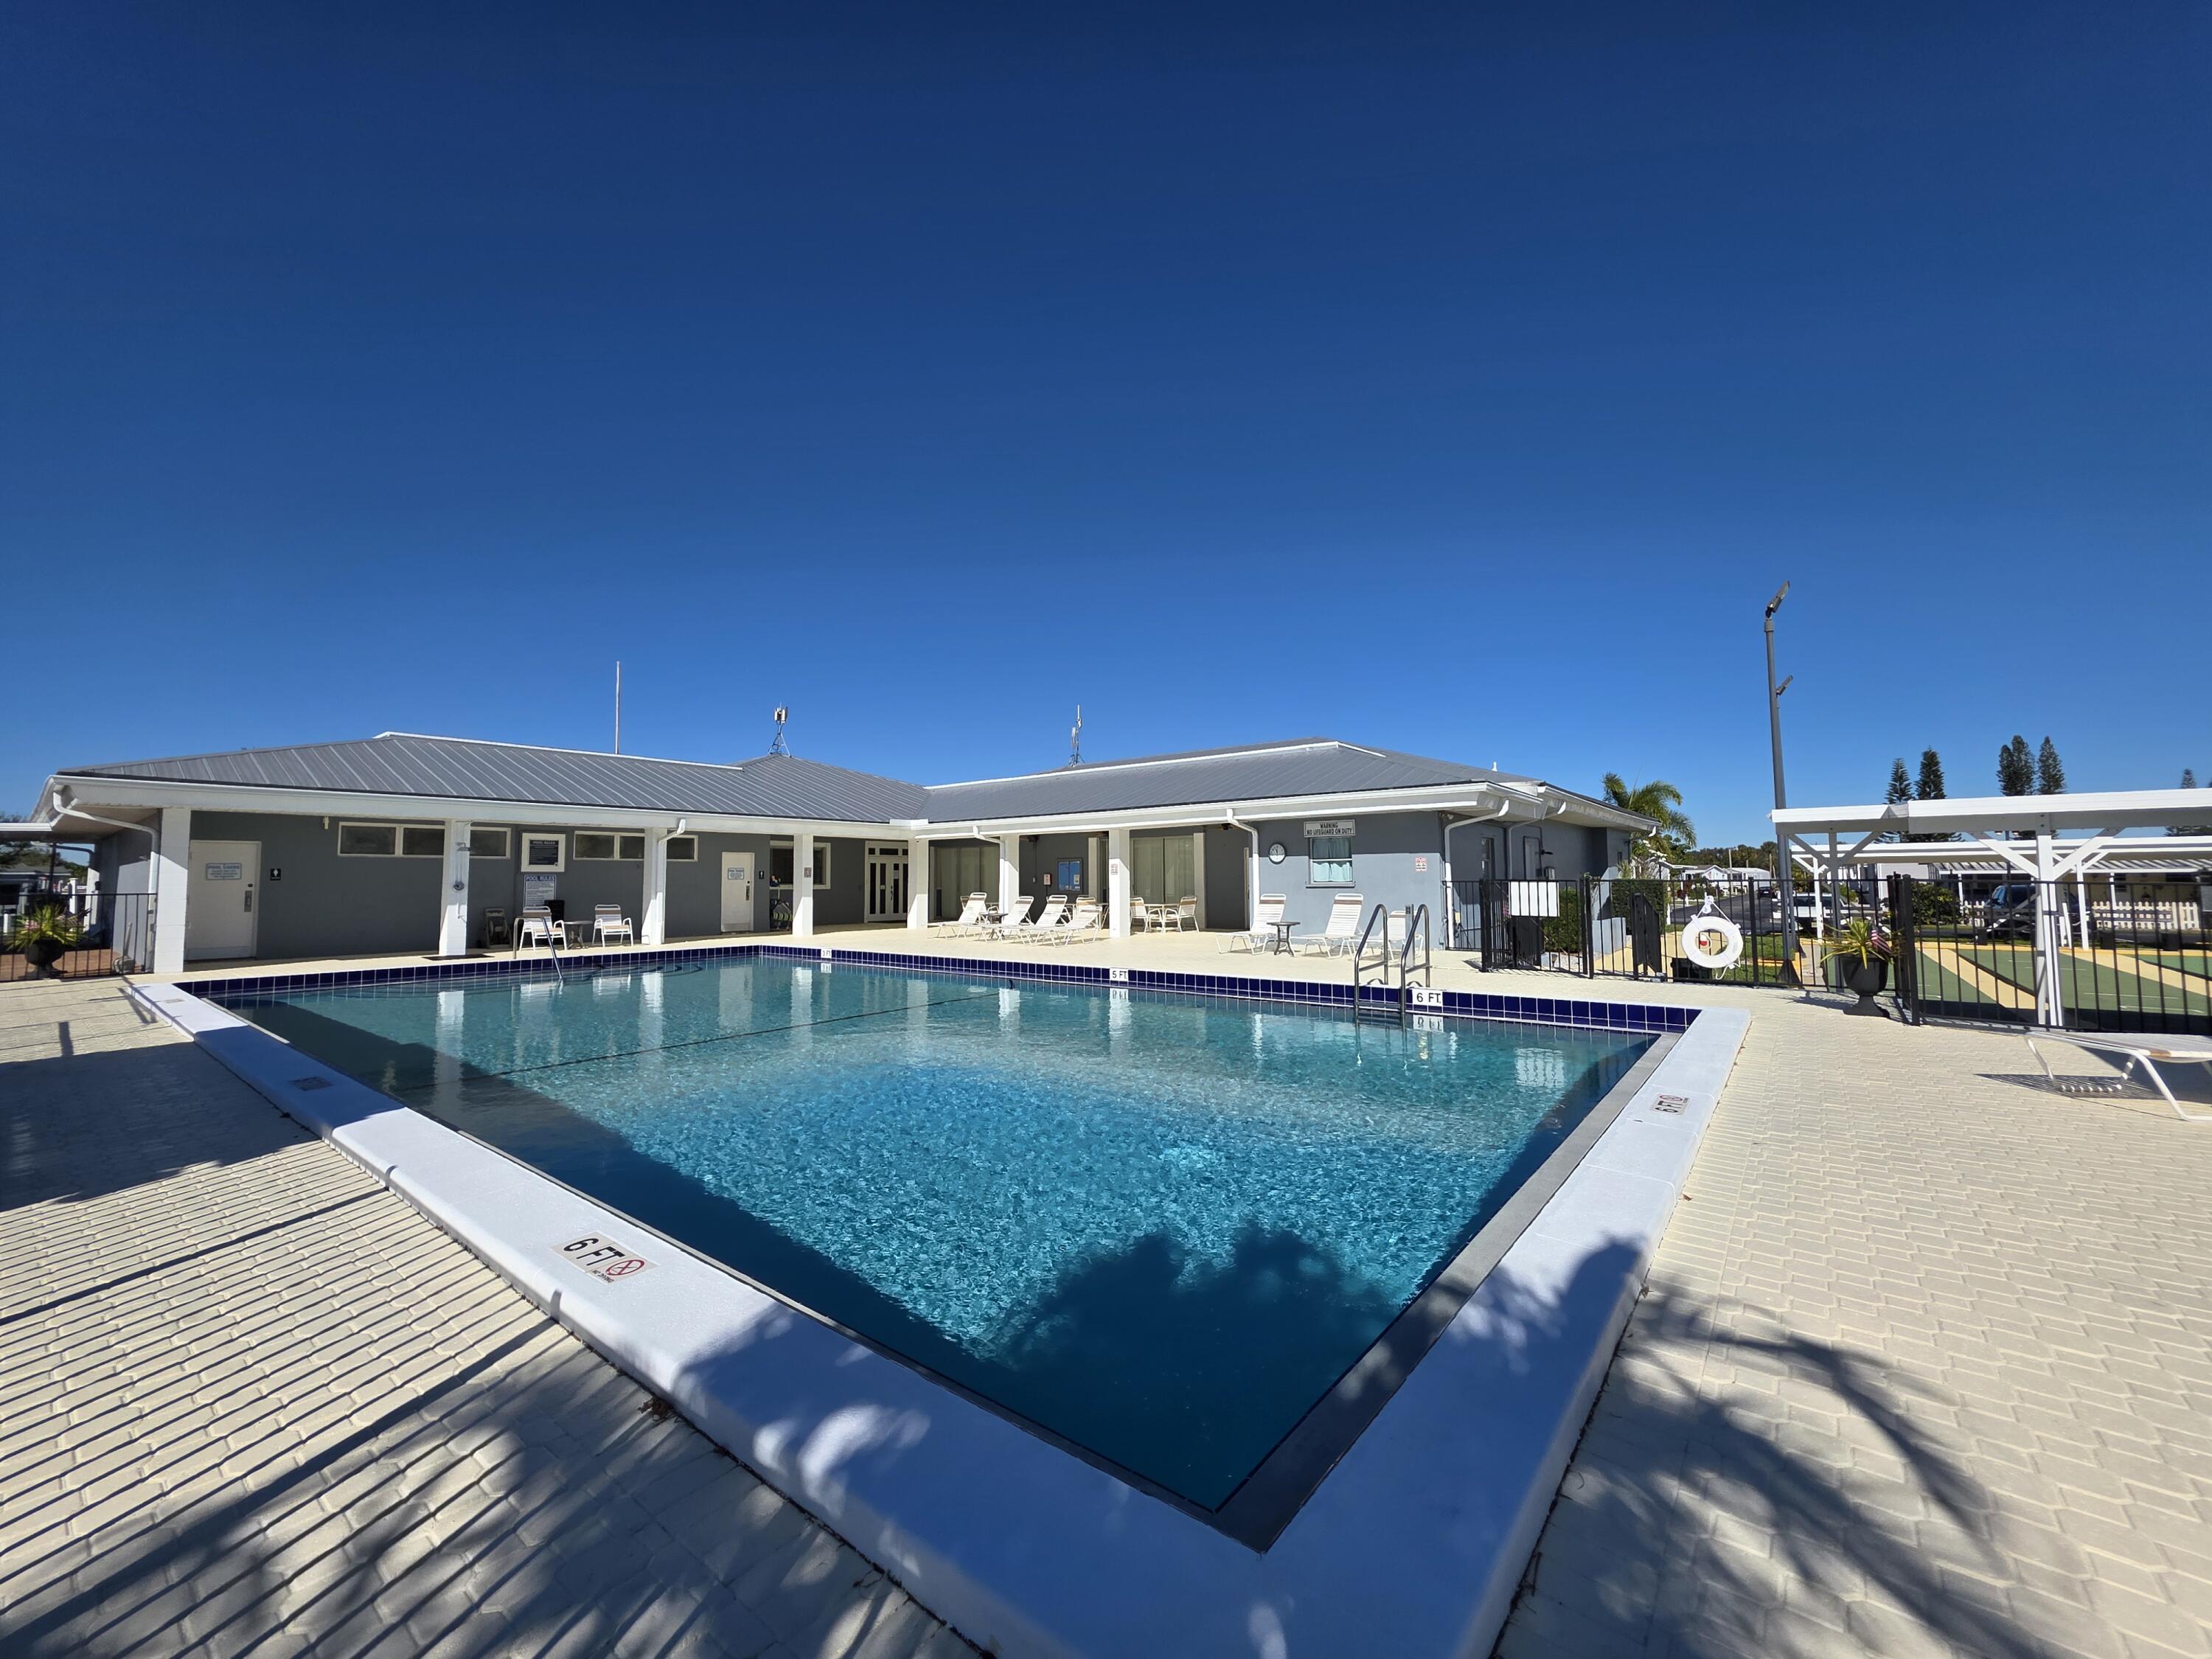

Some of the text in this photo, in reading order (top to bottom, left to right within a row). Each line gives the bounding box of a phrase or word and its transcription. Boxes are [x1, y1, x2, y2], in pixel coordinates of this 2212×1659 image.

[1112, 970, 1117, 978] 5
[1416, 992, 1423, 1003] 6
[1657, 1100, 1684, 1108] FT
[563, 1238, 625, 1266] 6 FT
